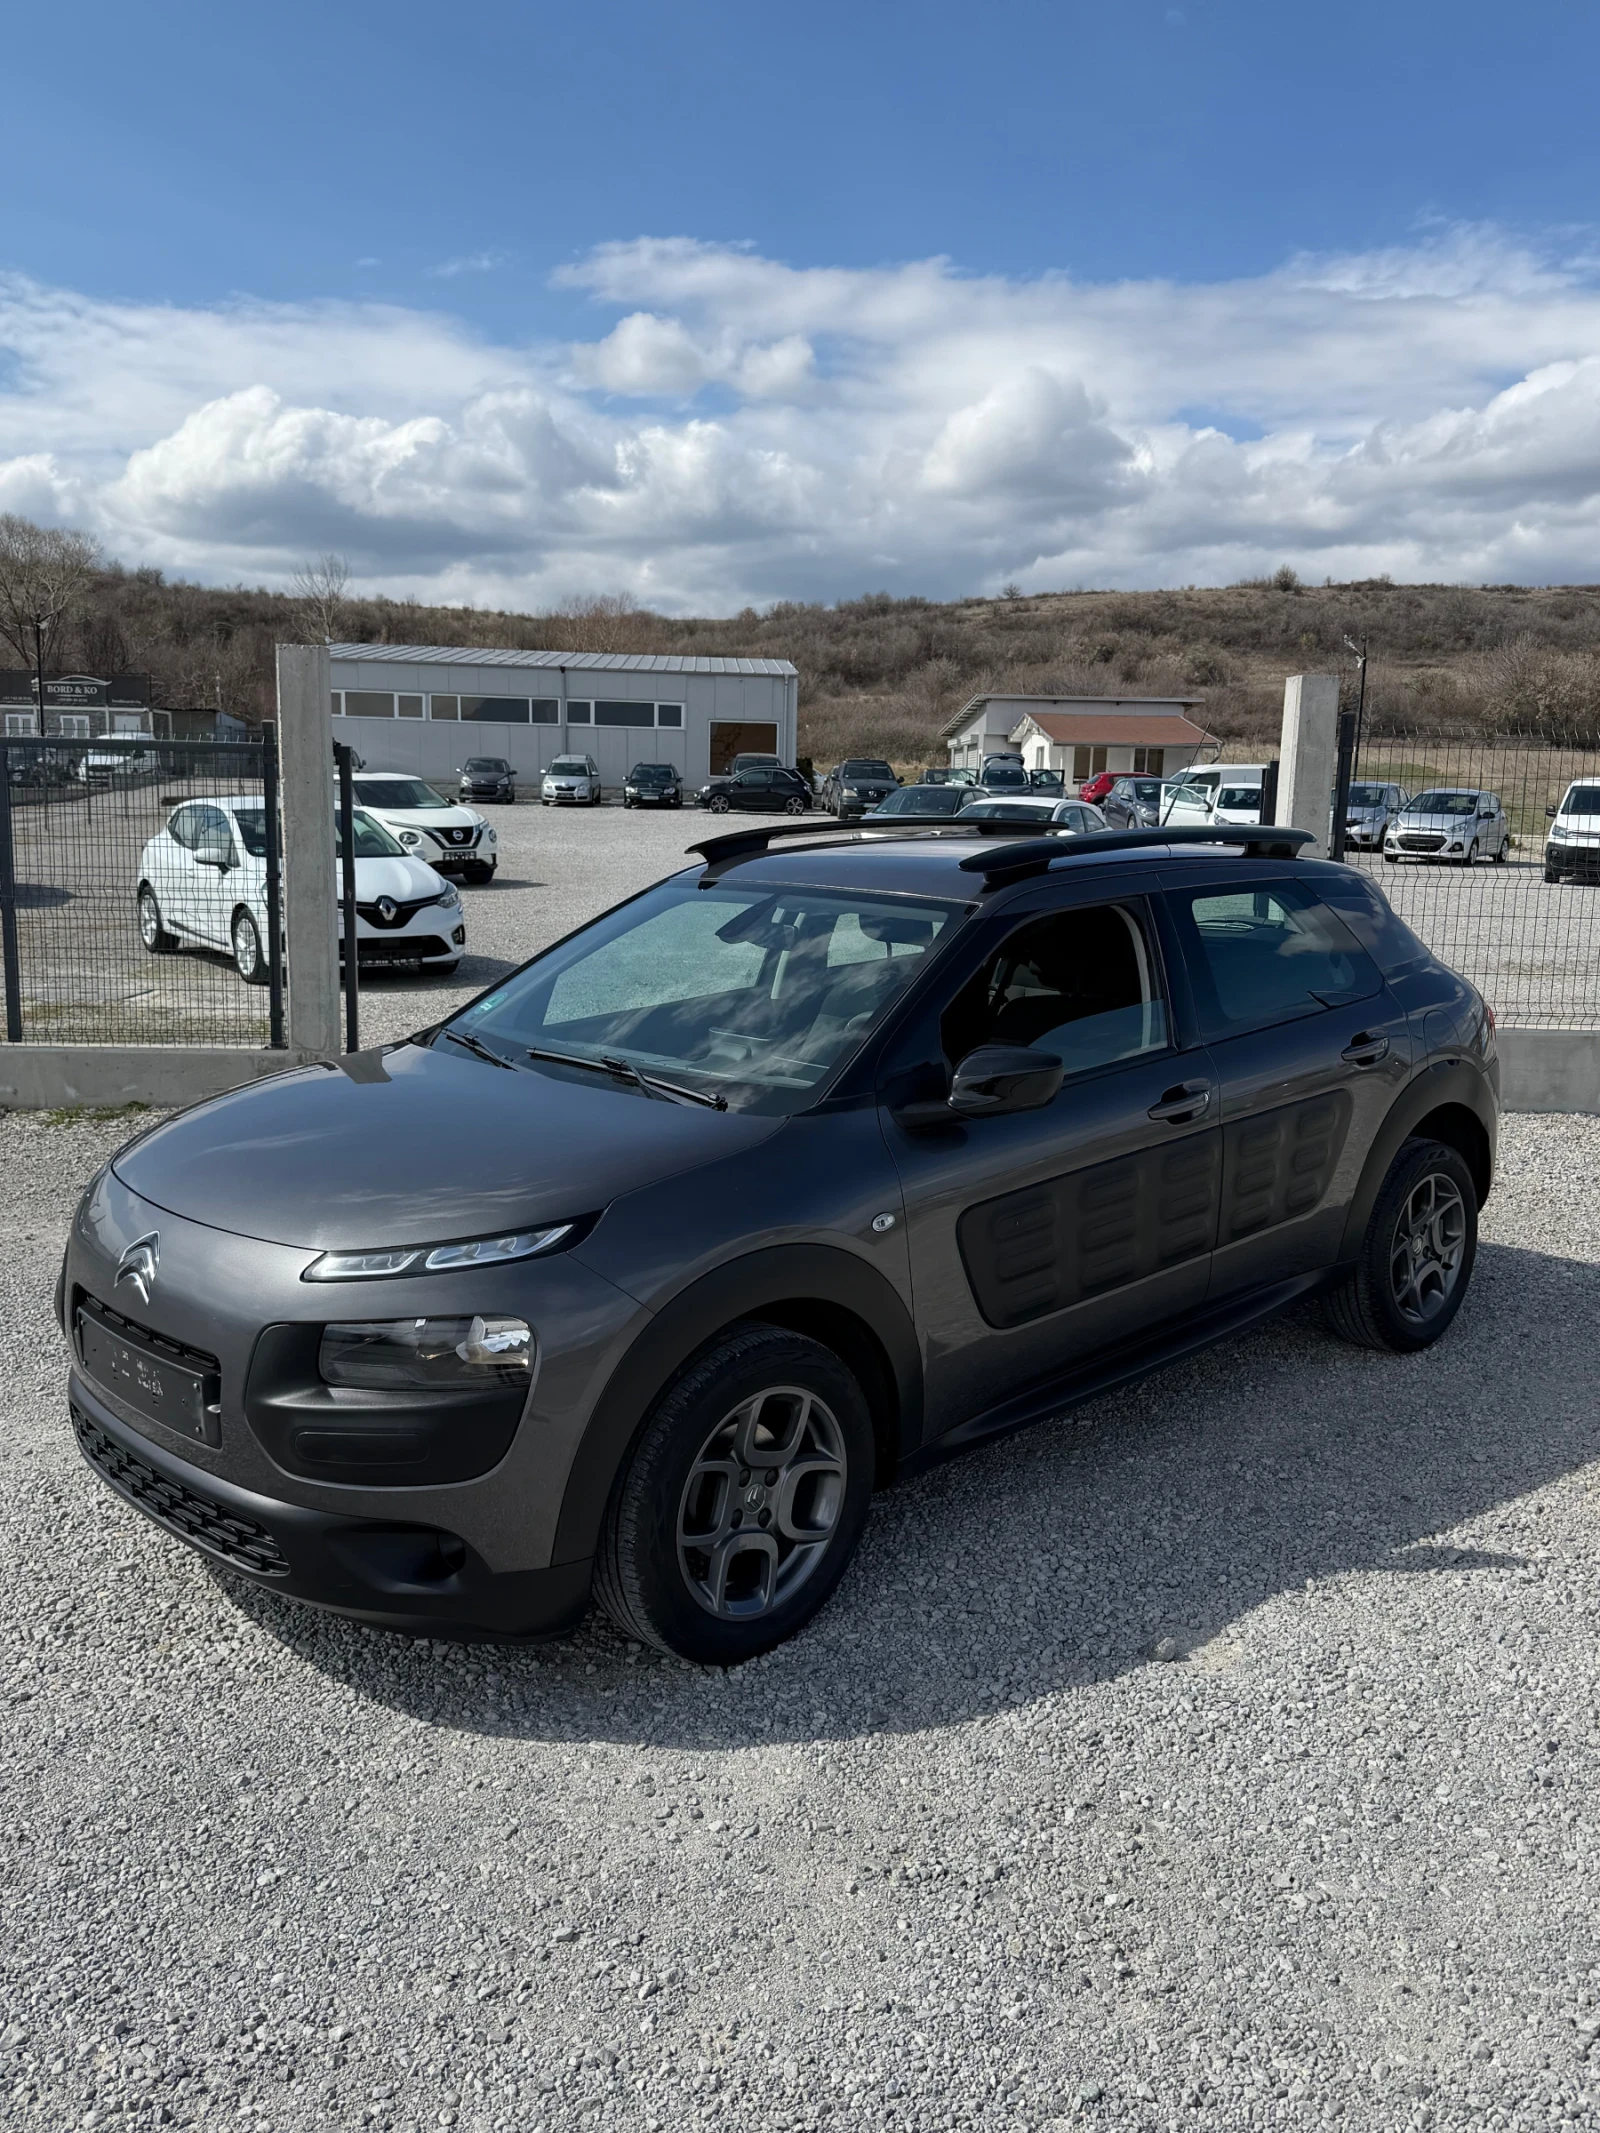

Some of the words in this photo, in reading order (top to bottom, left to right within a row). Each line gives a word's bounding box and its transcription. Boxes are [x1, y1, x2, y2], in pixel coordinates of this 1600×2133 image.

[47, 685, 74, 693] BORD
[75, 686, 82, 694] &
[84, 686, 98, 695] KO
